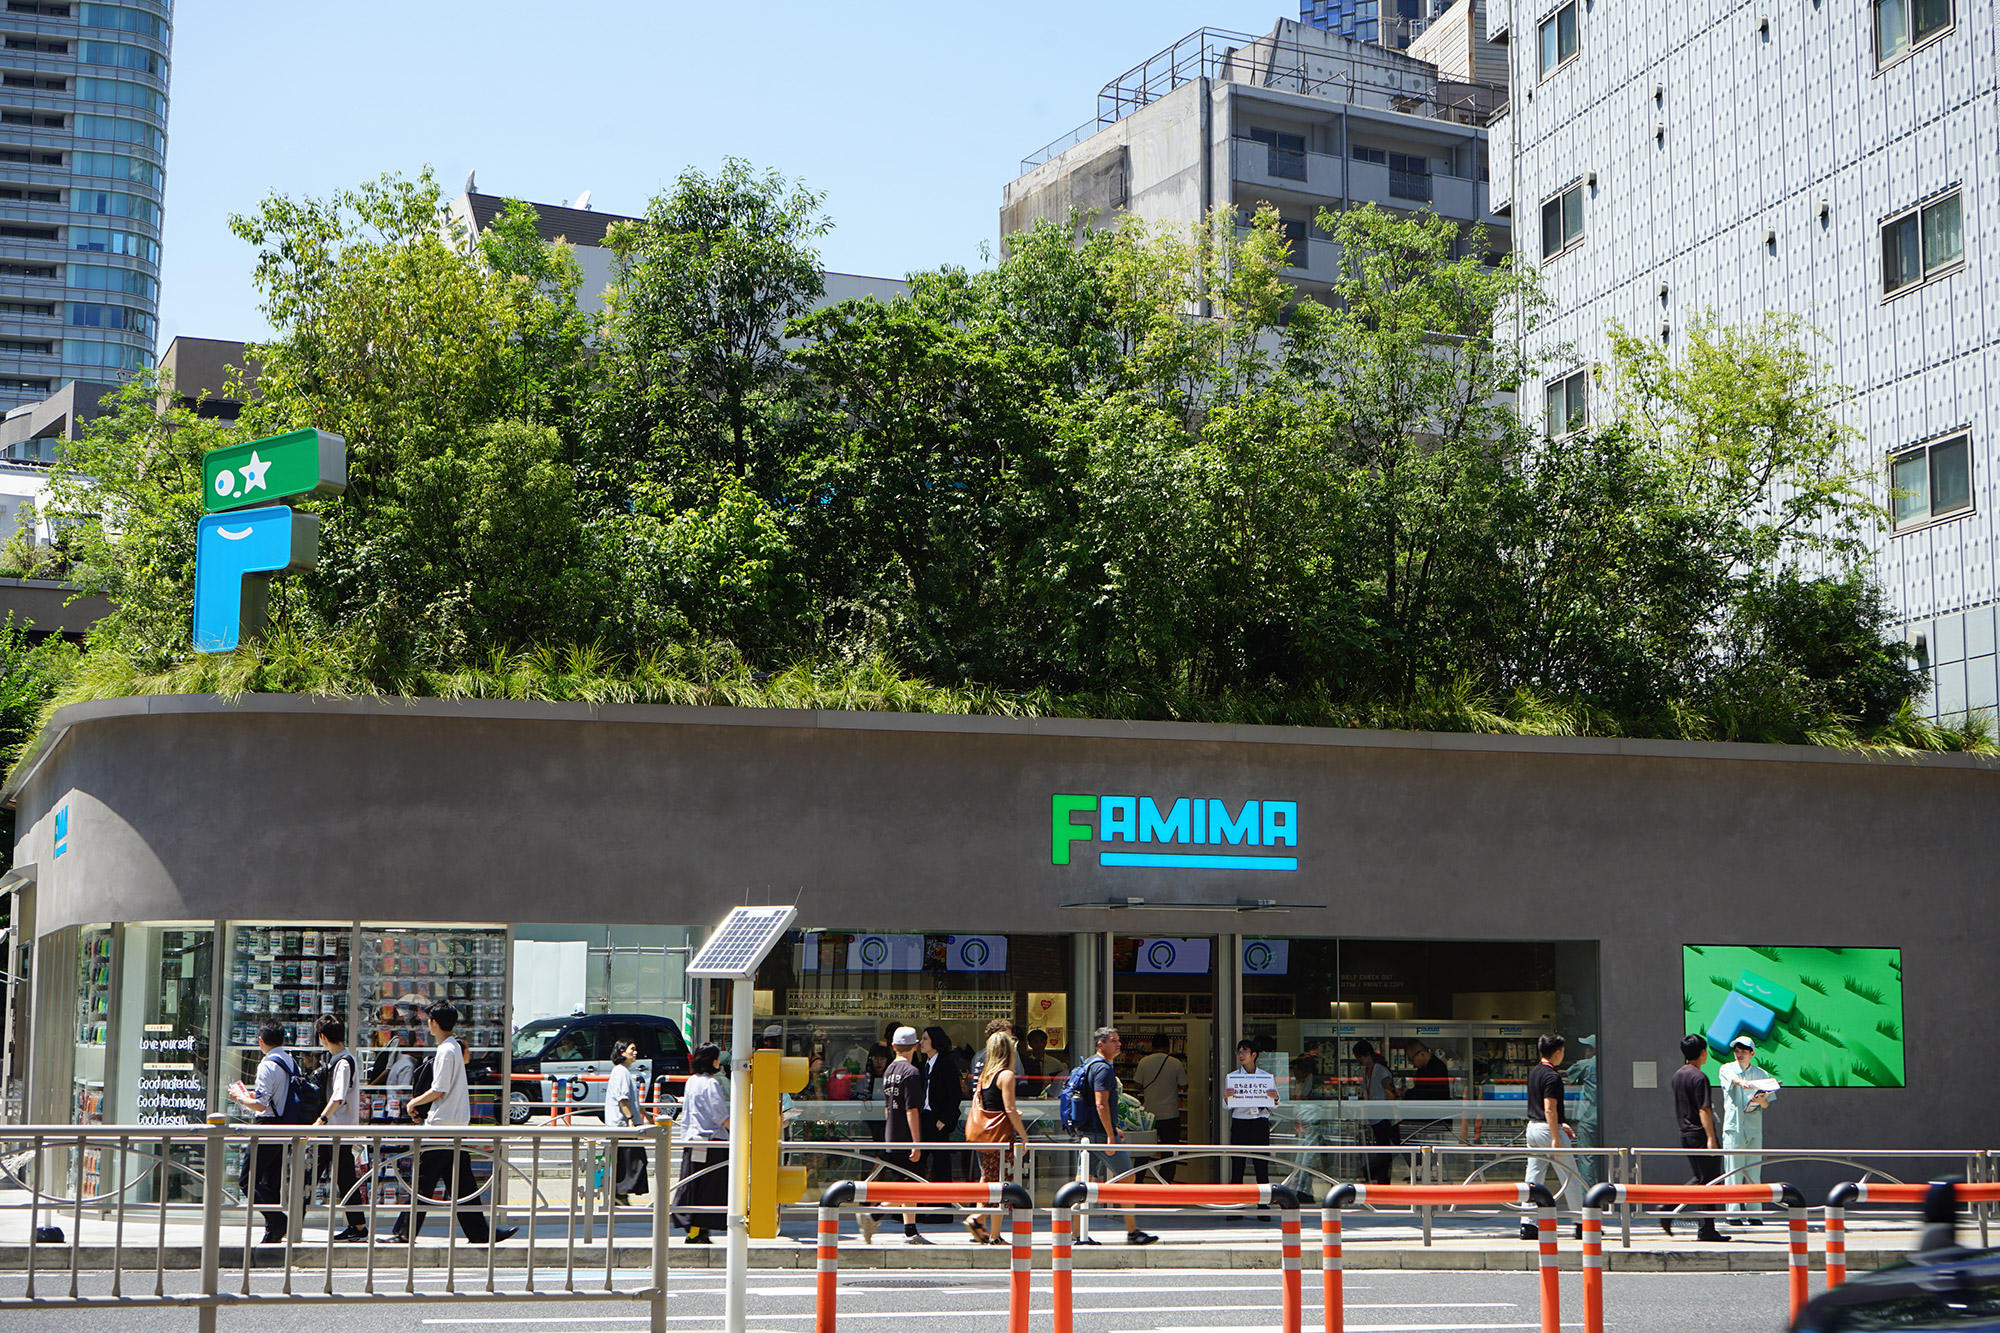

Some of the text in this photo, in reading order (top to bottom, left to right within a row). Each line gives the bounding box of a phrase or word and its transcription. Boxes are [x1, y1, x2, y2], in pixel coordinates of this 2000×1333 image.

[1051, 794, 1298, 866] FAMIMA
[140, 1036, 159, 1050] Love
[138, 1075, 200, 1091] Good materials,
[137, 1094, 160, 1107] Good
[137, 1112, 159, 1125] Good
